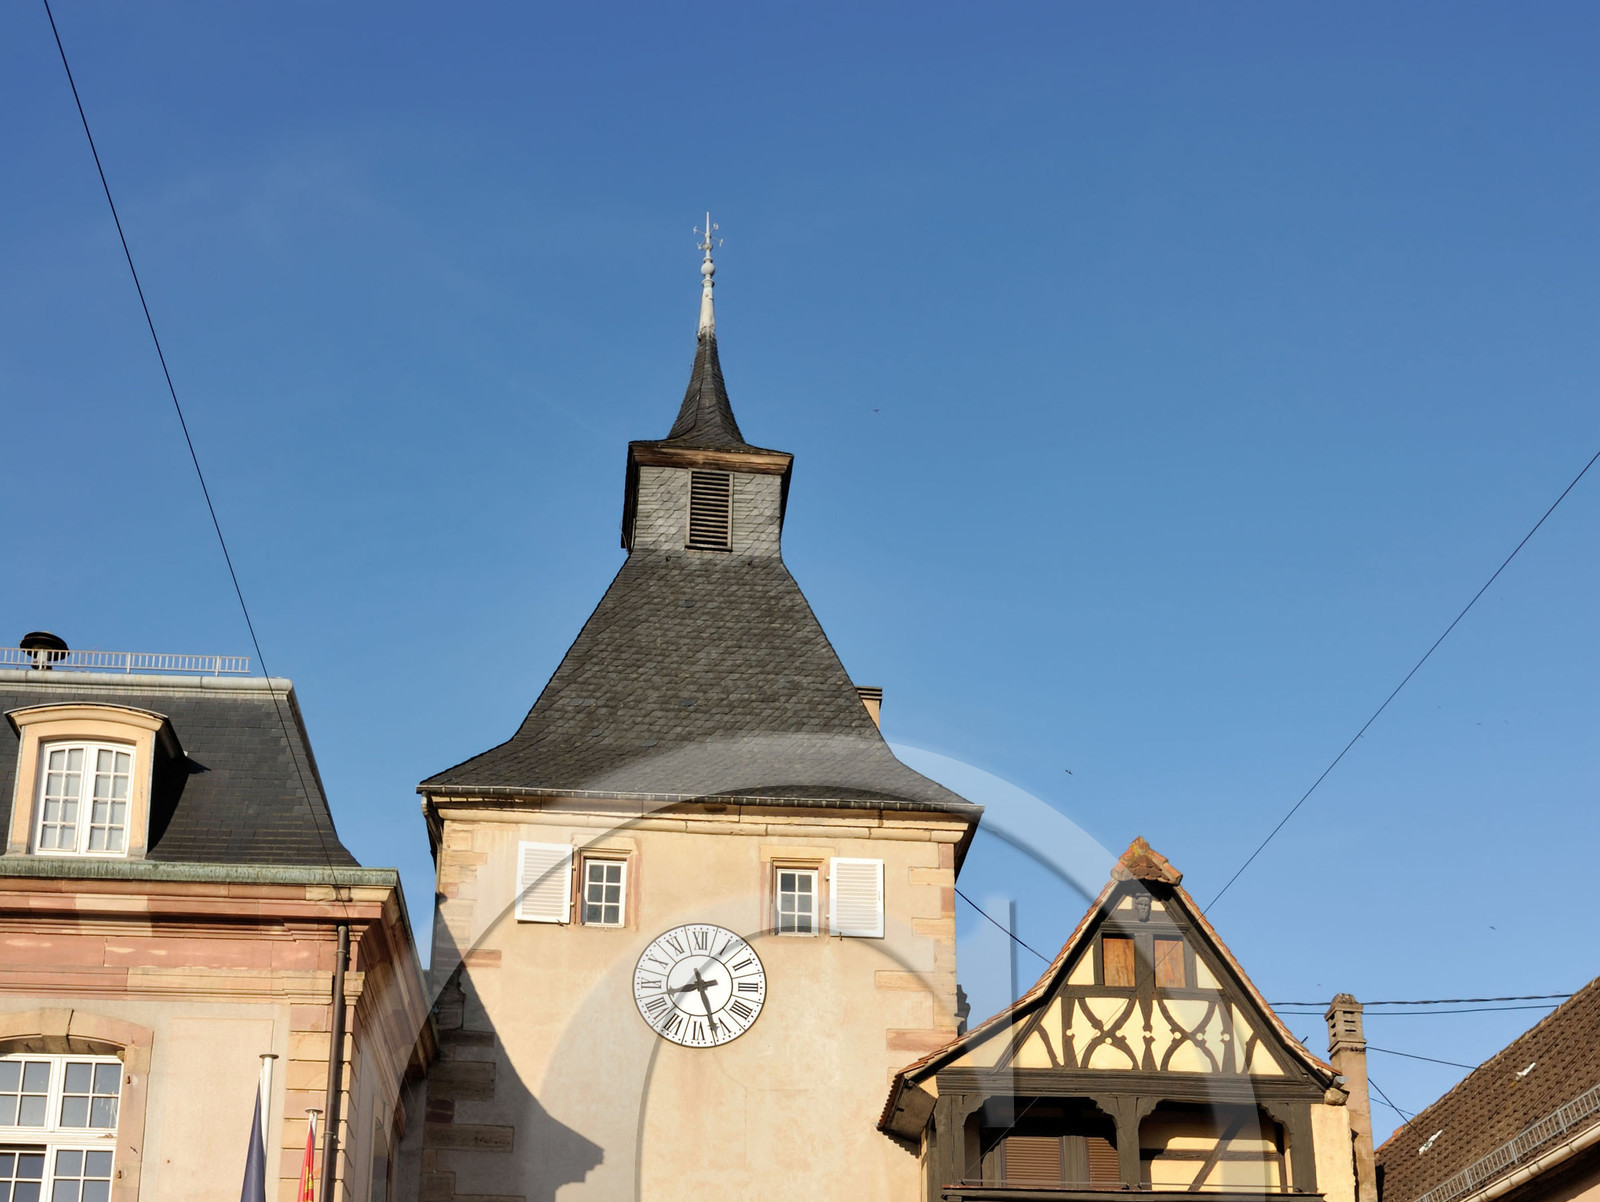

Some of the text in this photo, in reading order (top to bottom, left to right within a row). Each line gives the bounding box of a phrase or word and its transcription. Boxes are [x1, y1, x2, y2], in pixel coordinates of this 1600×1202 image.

[666, 935, 685, 956] XI
[692, 931, 708, 951] XII
[648, 953, 668, 969] X
[733, 957, 753, 972] II
[641, 977, 662, 989] IX
[738, 982, 759, 992] III
[645, 996, 669, 1020] VIII
[663, 1013, 684, 1036] VII
[692, 1021, 706, 1041] VI
[718, 1017, 732, 1036] V
